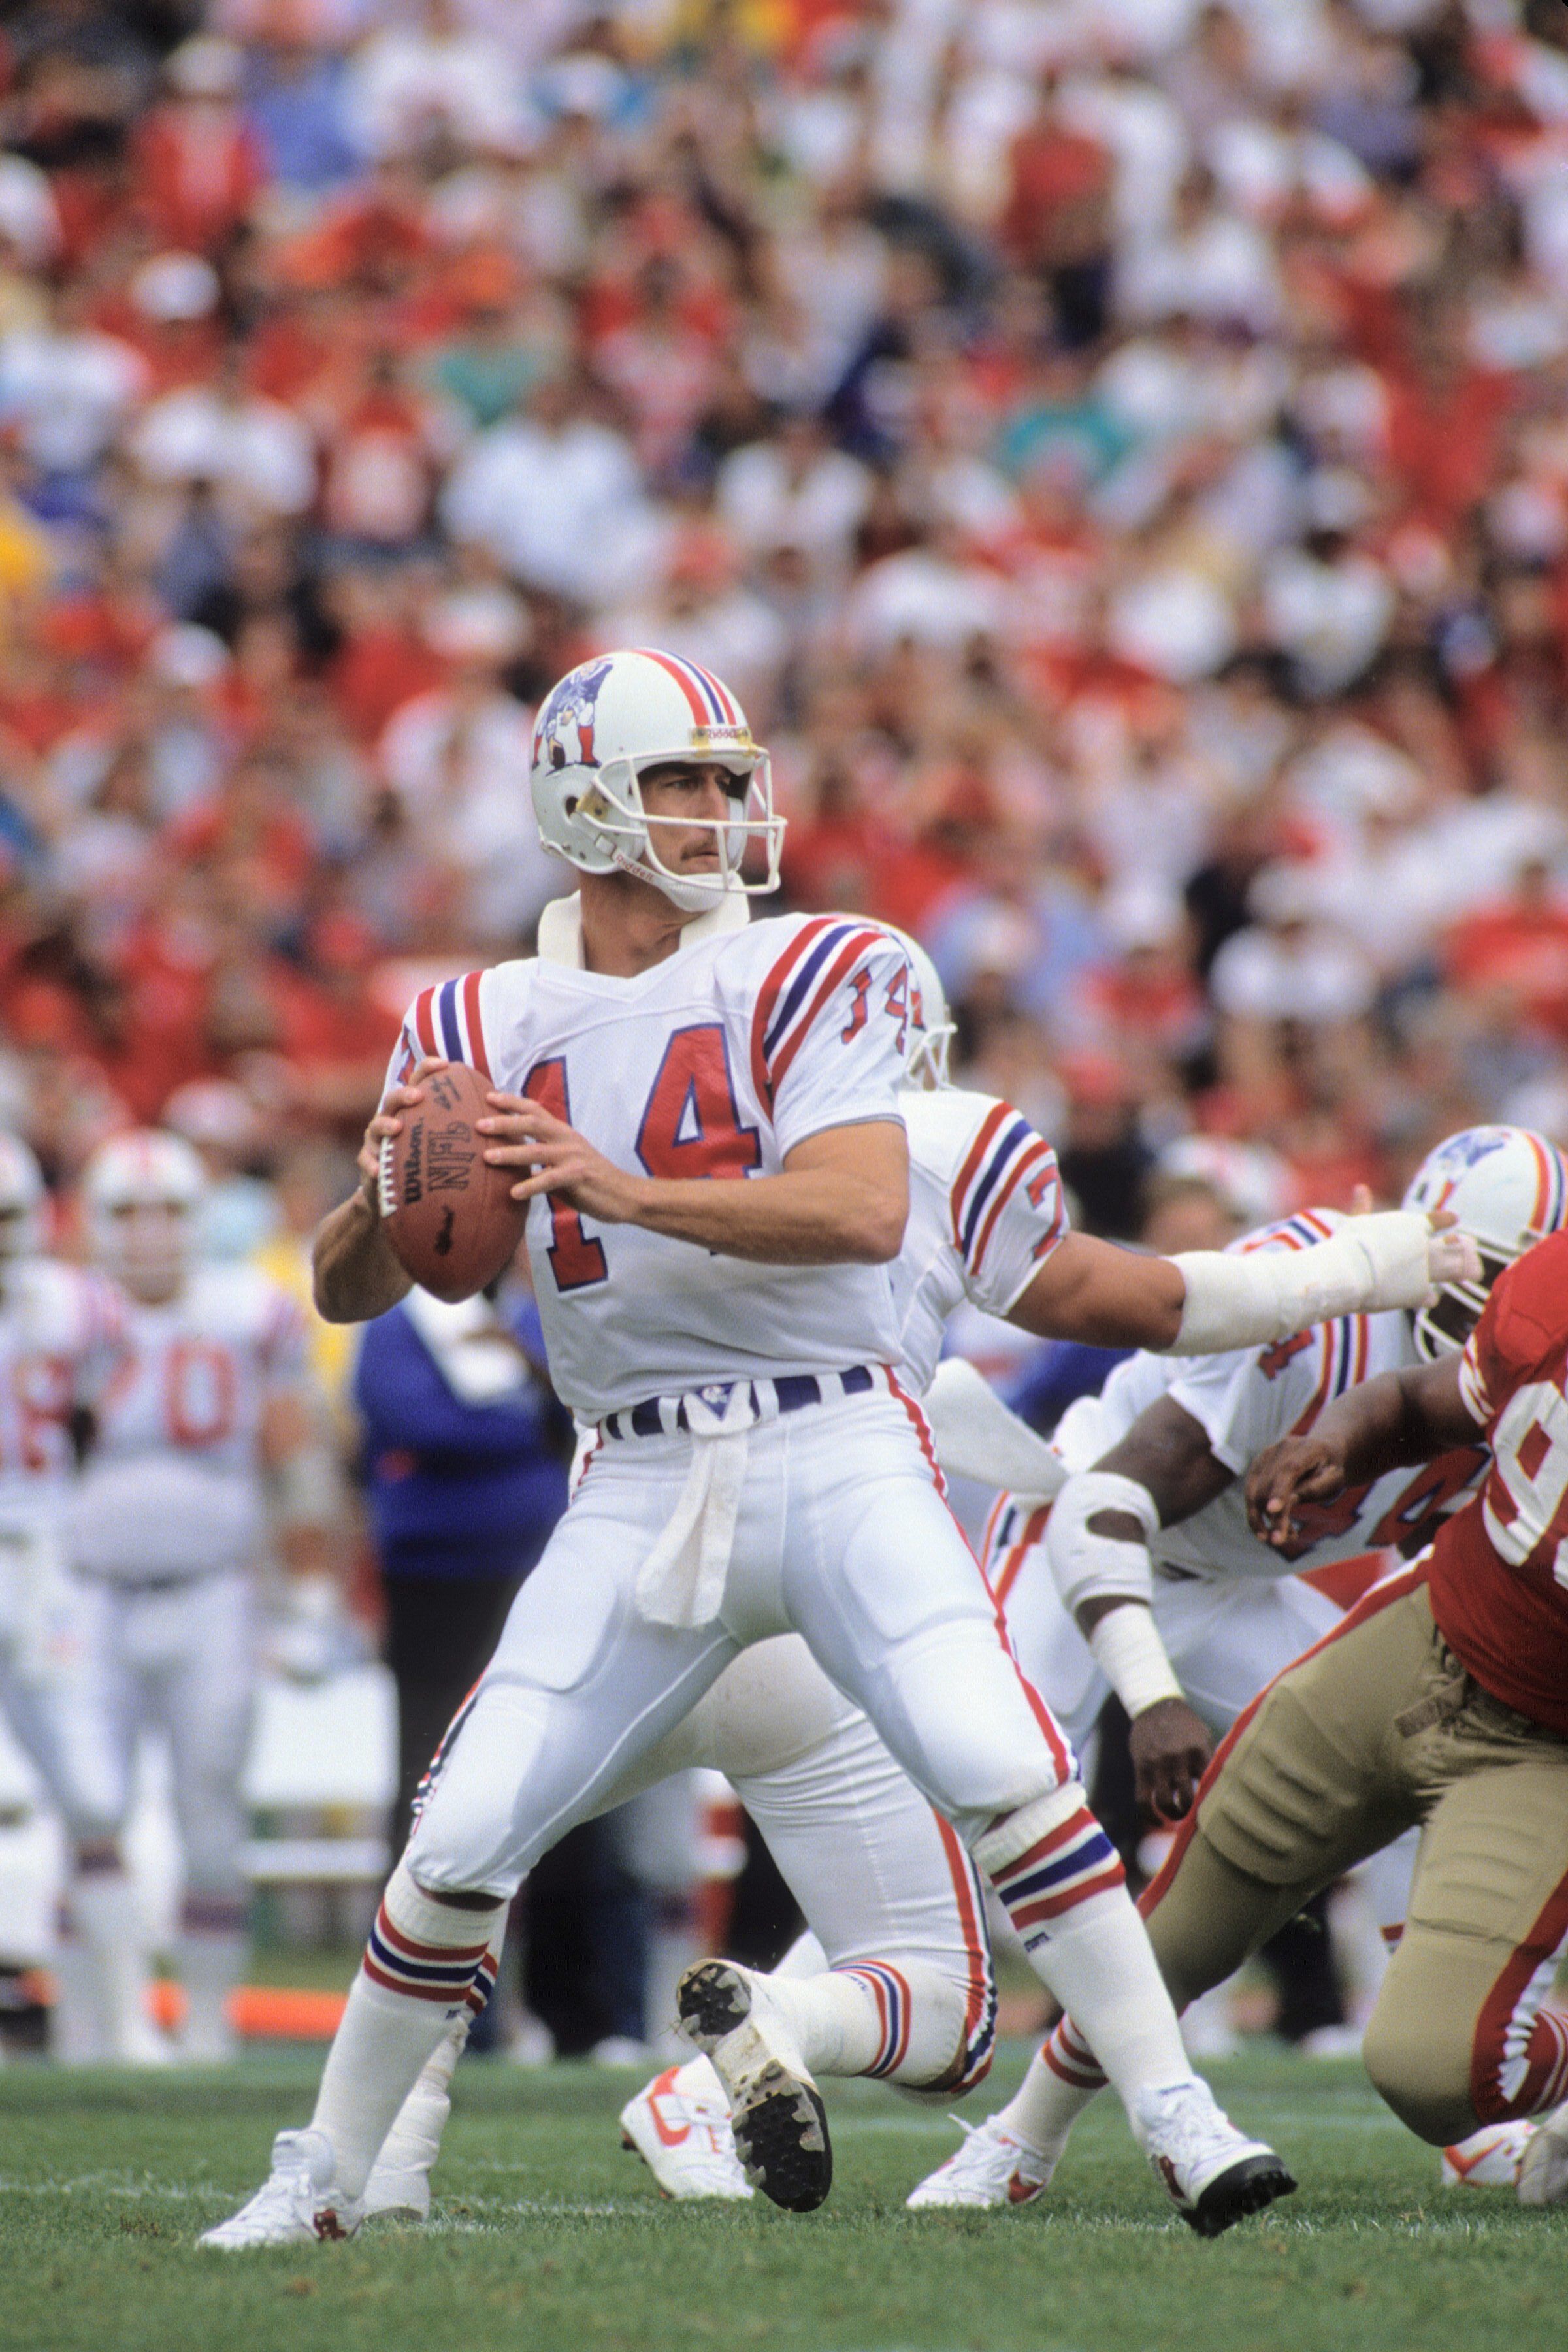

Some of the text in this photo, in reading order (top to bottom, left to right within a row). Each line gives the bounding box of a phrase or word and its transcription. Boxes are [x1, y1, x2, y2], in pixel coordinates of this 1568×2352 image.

[615, 854, 655, 880] Riddell
[427, 1121, 477, 1193] NFL
[522, 1022, 763, 1292] 14
